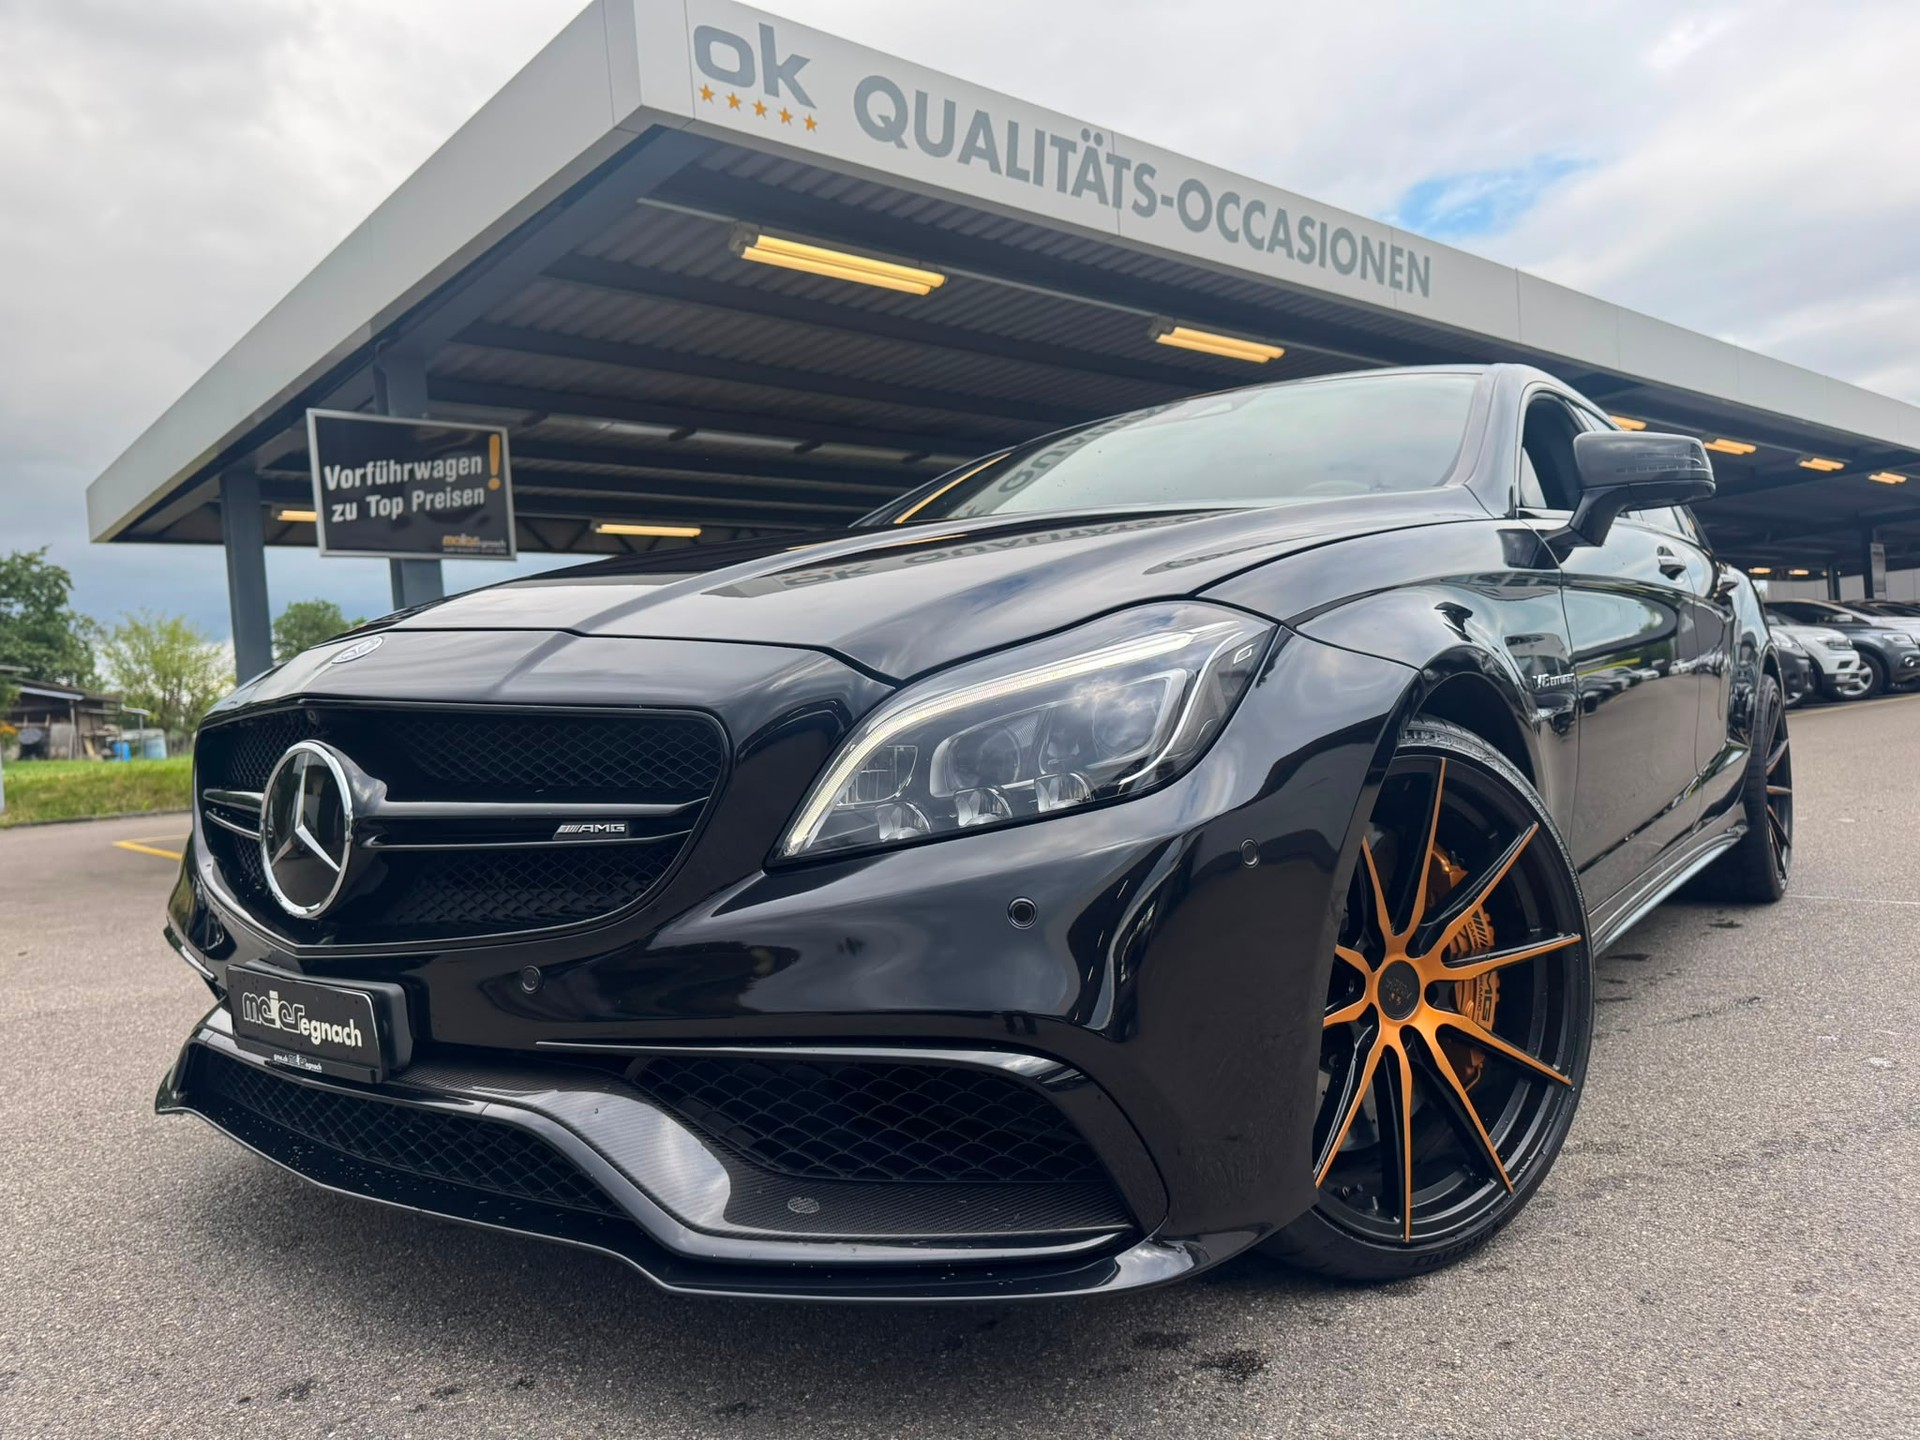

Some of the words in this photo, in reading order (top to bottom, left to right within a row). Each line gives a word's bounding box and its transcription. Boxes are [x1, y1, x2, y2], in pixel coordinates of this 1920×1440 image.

[694, 22, 817, 109] ok
[853, 74, 1431, 298] QUALITÄTS-OCCASIONEN
[323, 456, 483, 491] Vorführwagen
[331, 502, 358, 523] zu
[366, 494, 404, 521] Top
[412, 487, 485, 512] Preisen
[578, 823, 625, 833] AMG
